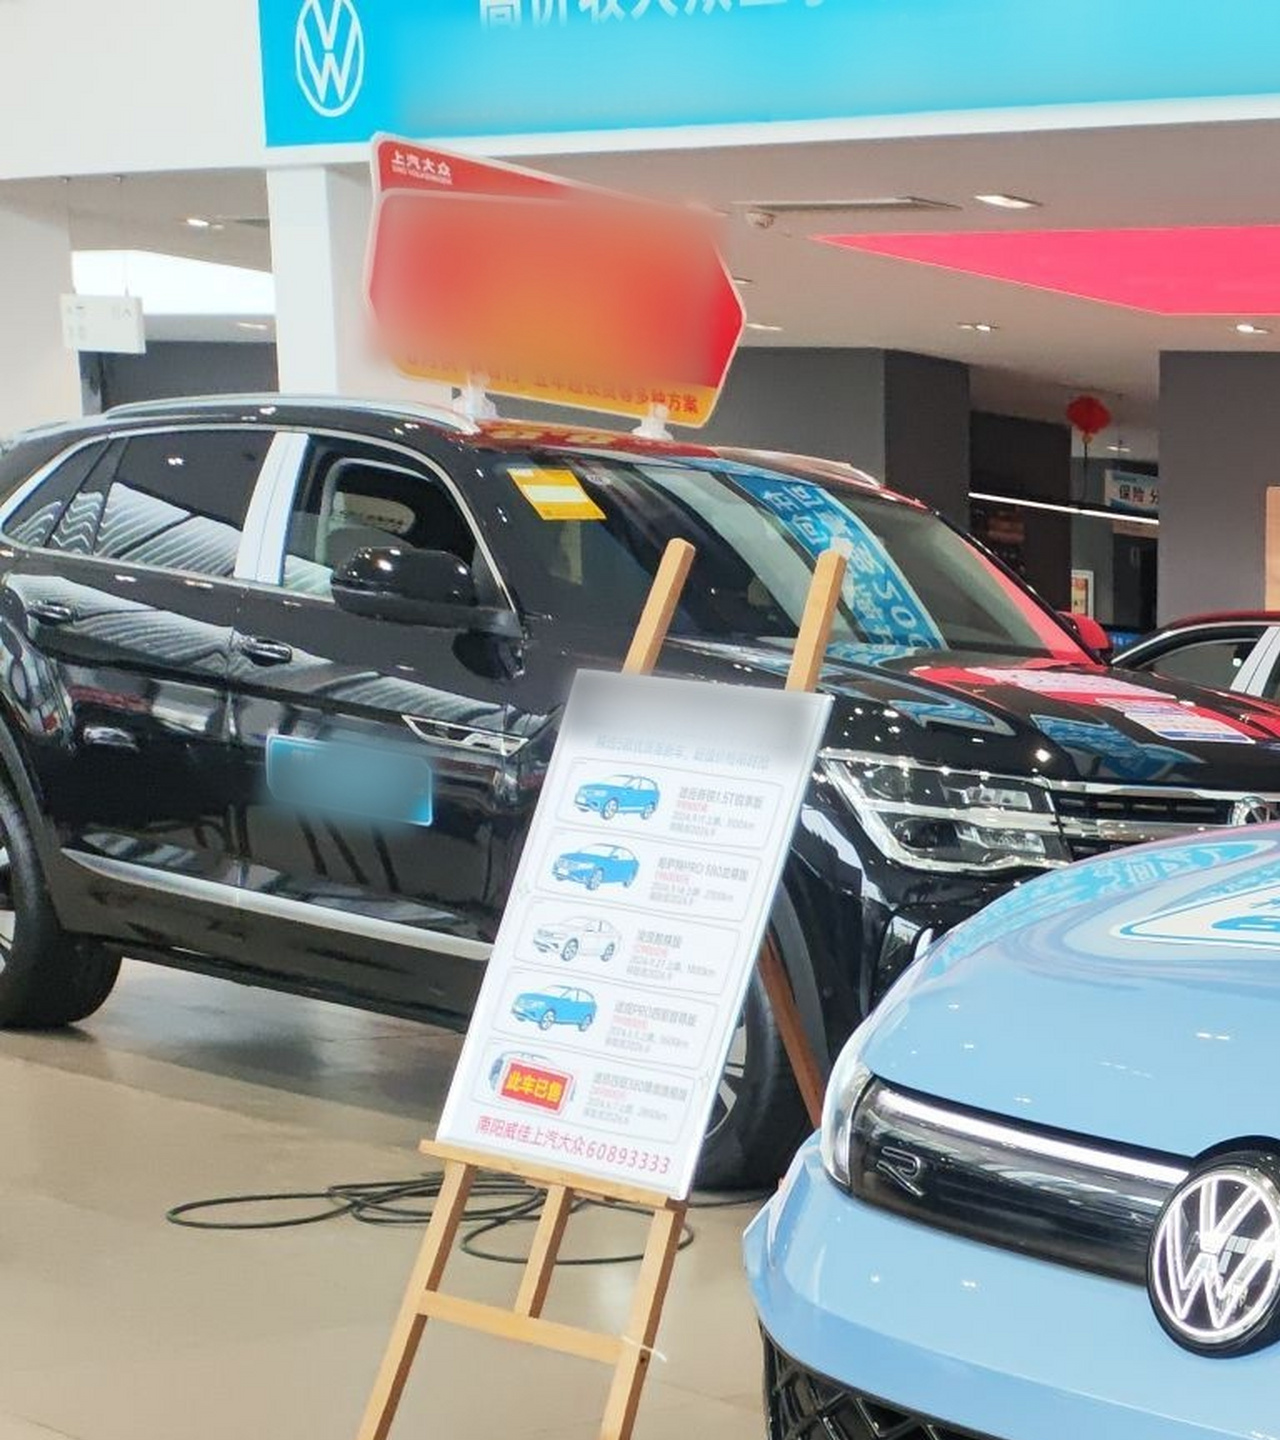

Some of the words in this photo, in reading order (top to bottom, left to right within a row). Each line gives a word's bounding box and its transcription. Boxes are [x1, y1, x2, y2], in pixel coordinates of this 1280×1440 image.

[391, 150, 452, 177] 上汽大众
[504, 1070, 563, 1104] 此车已售
